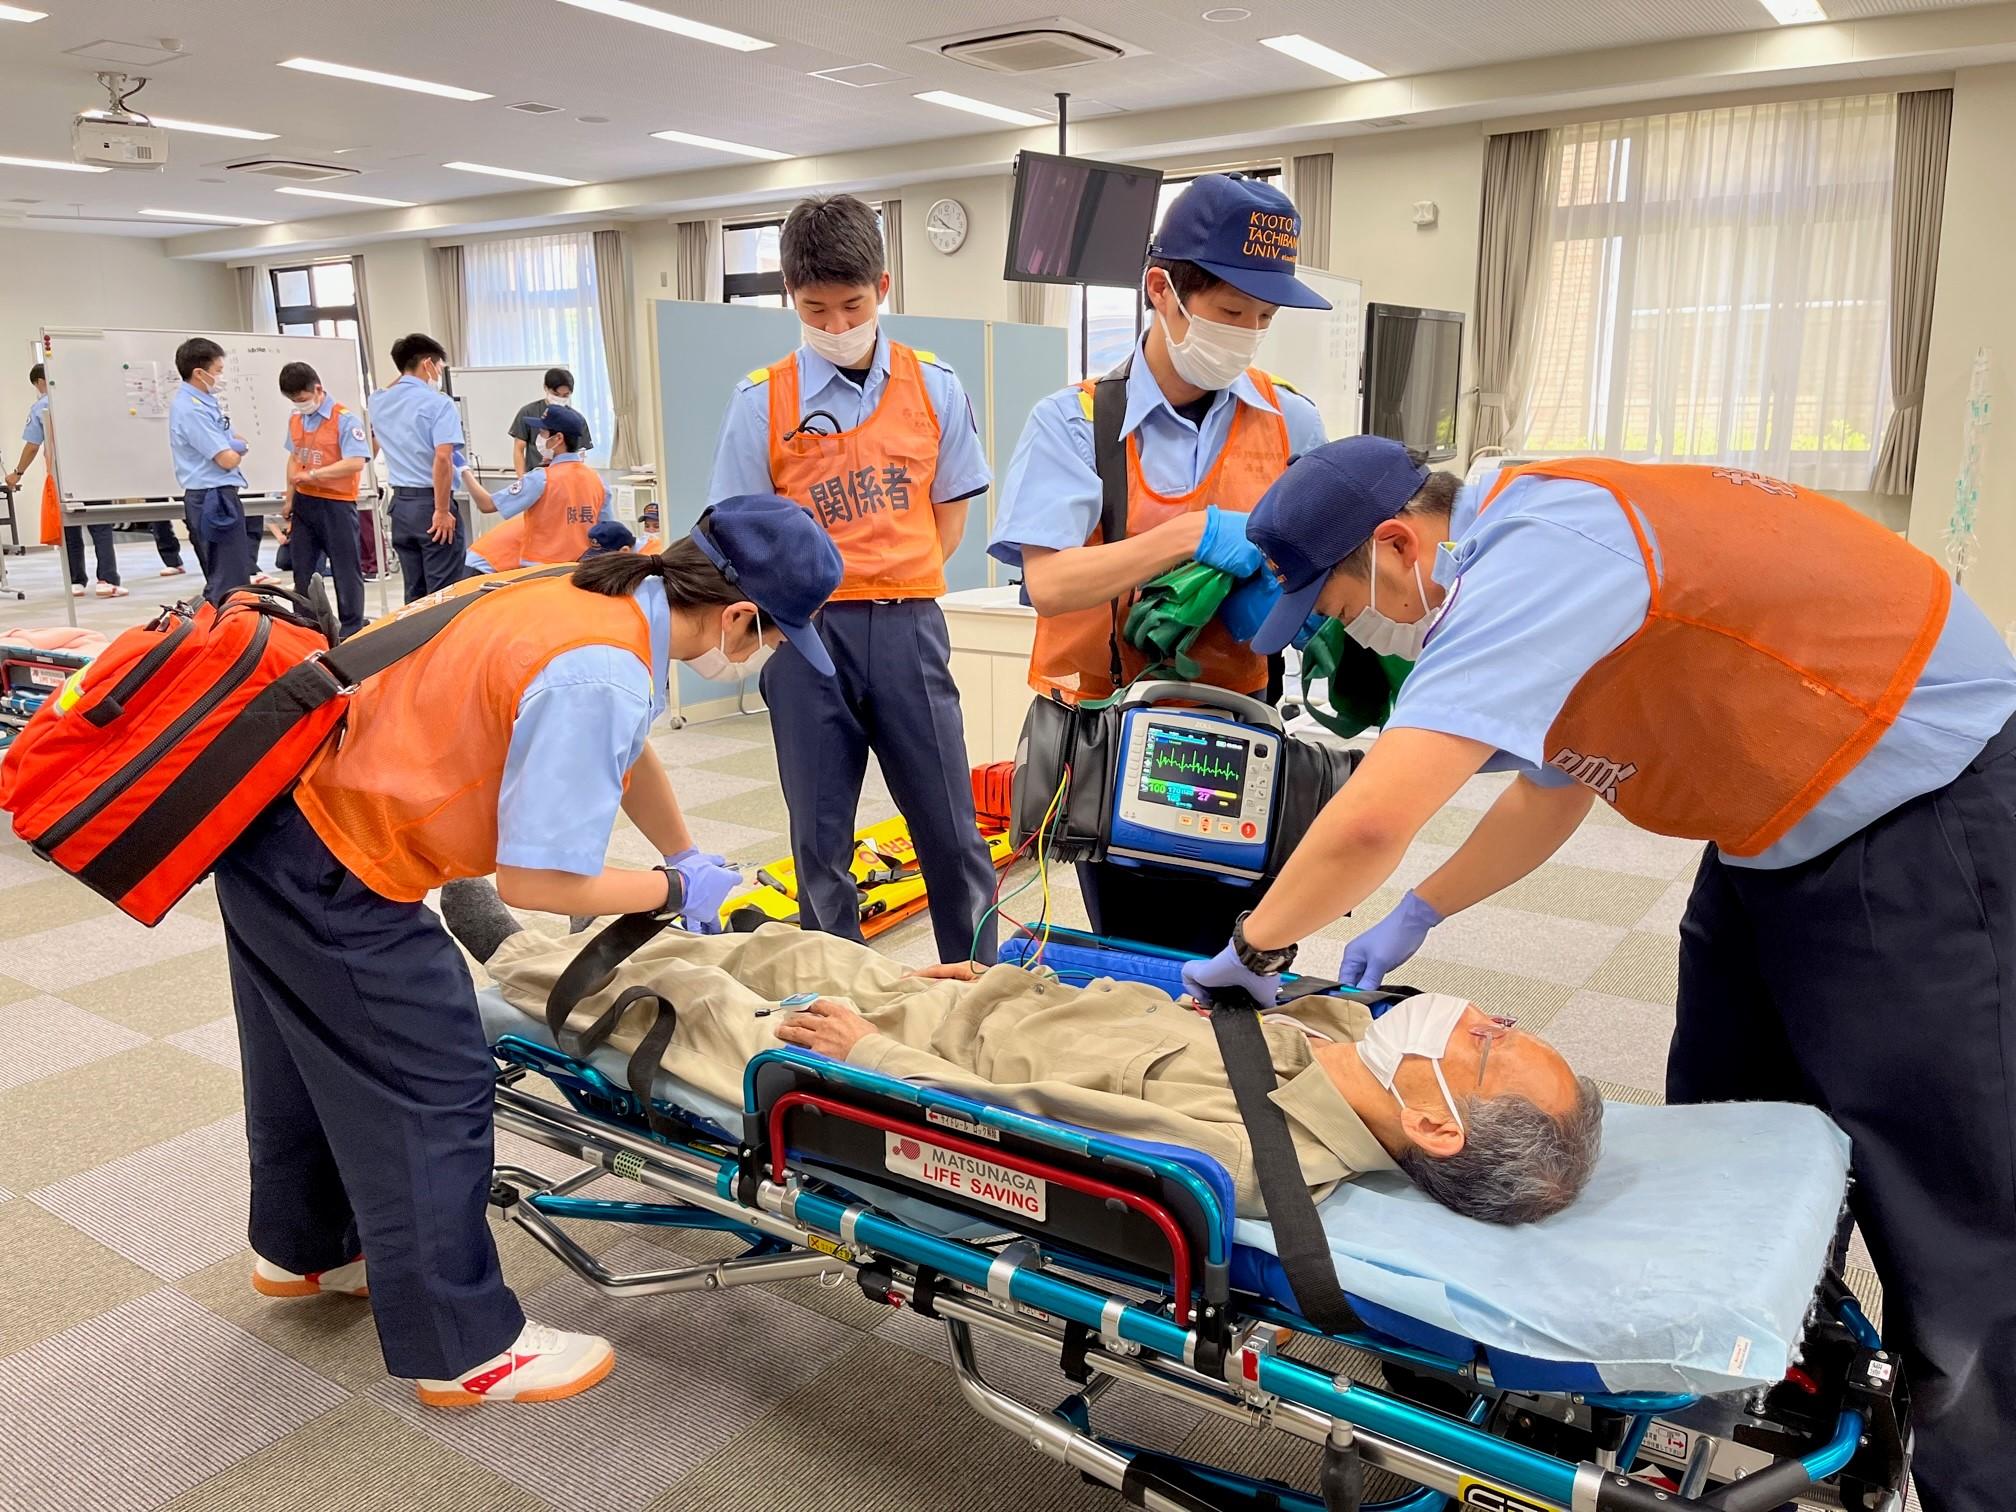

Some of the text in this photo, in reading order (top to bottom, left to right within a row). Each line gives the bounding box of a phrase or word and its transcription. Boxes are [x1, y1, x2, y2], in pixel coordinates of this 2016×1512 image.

[1250, 211, 1293, 232] KYOTO
[1243, 241, 1280, 259] UNIV
[809, 463, 912, 528] 関係者
[567, 506, 593, 524] 隊長
[1197, 793, 1210, 801] 27
[932, 1149, 1038, 1194] MATSUNAGA
[923, 1163, 1039, 1213] LIFE SAVING
